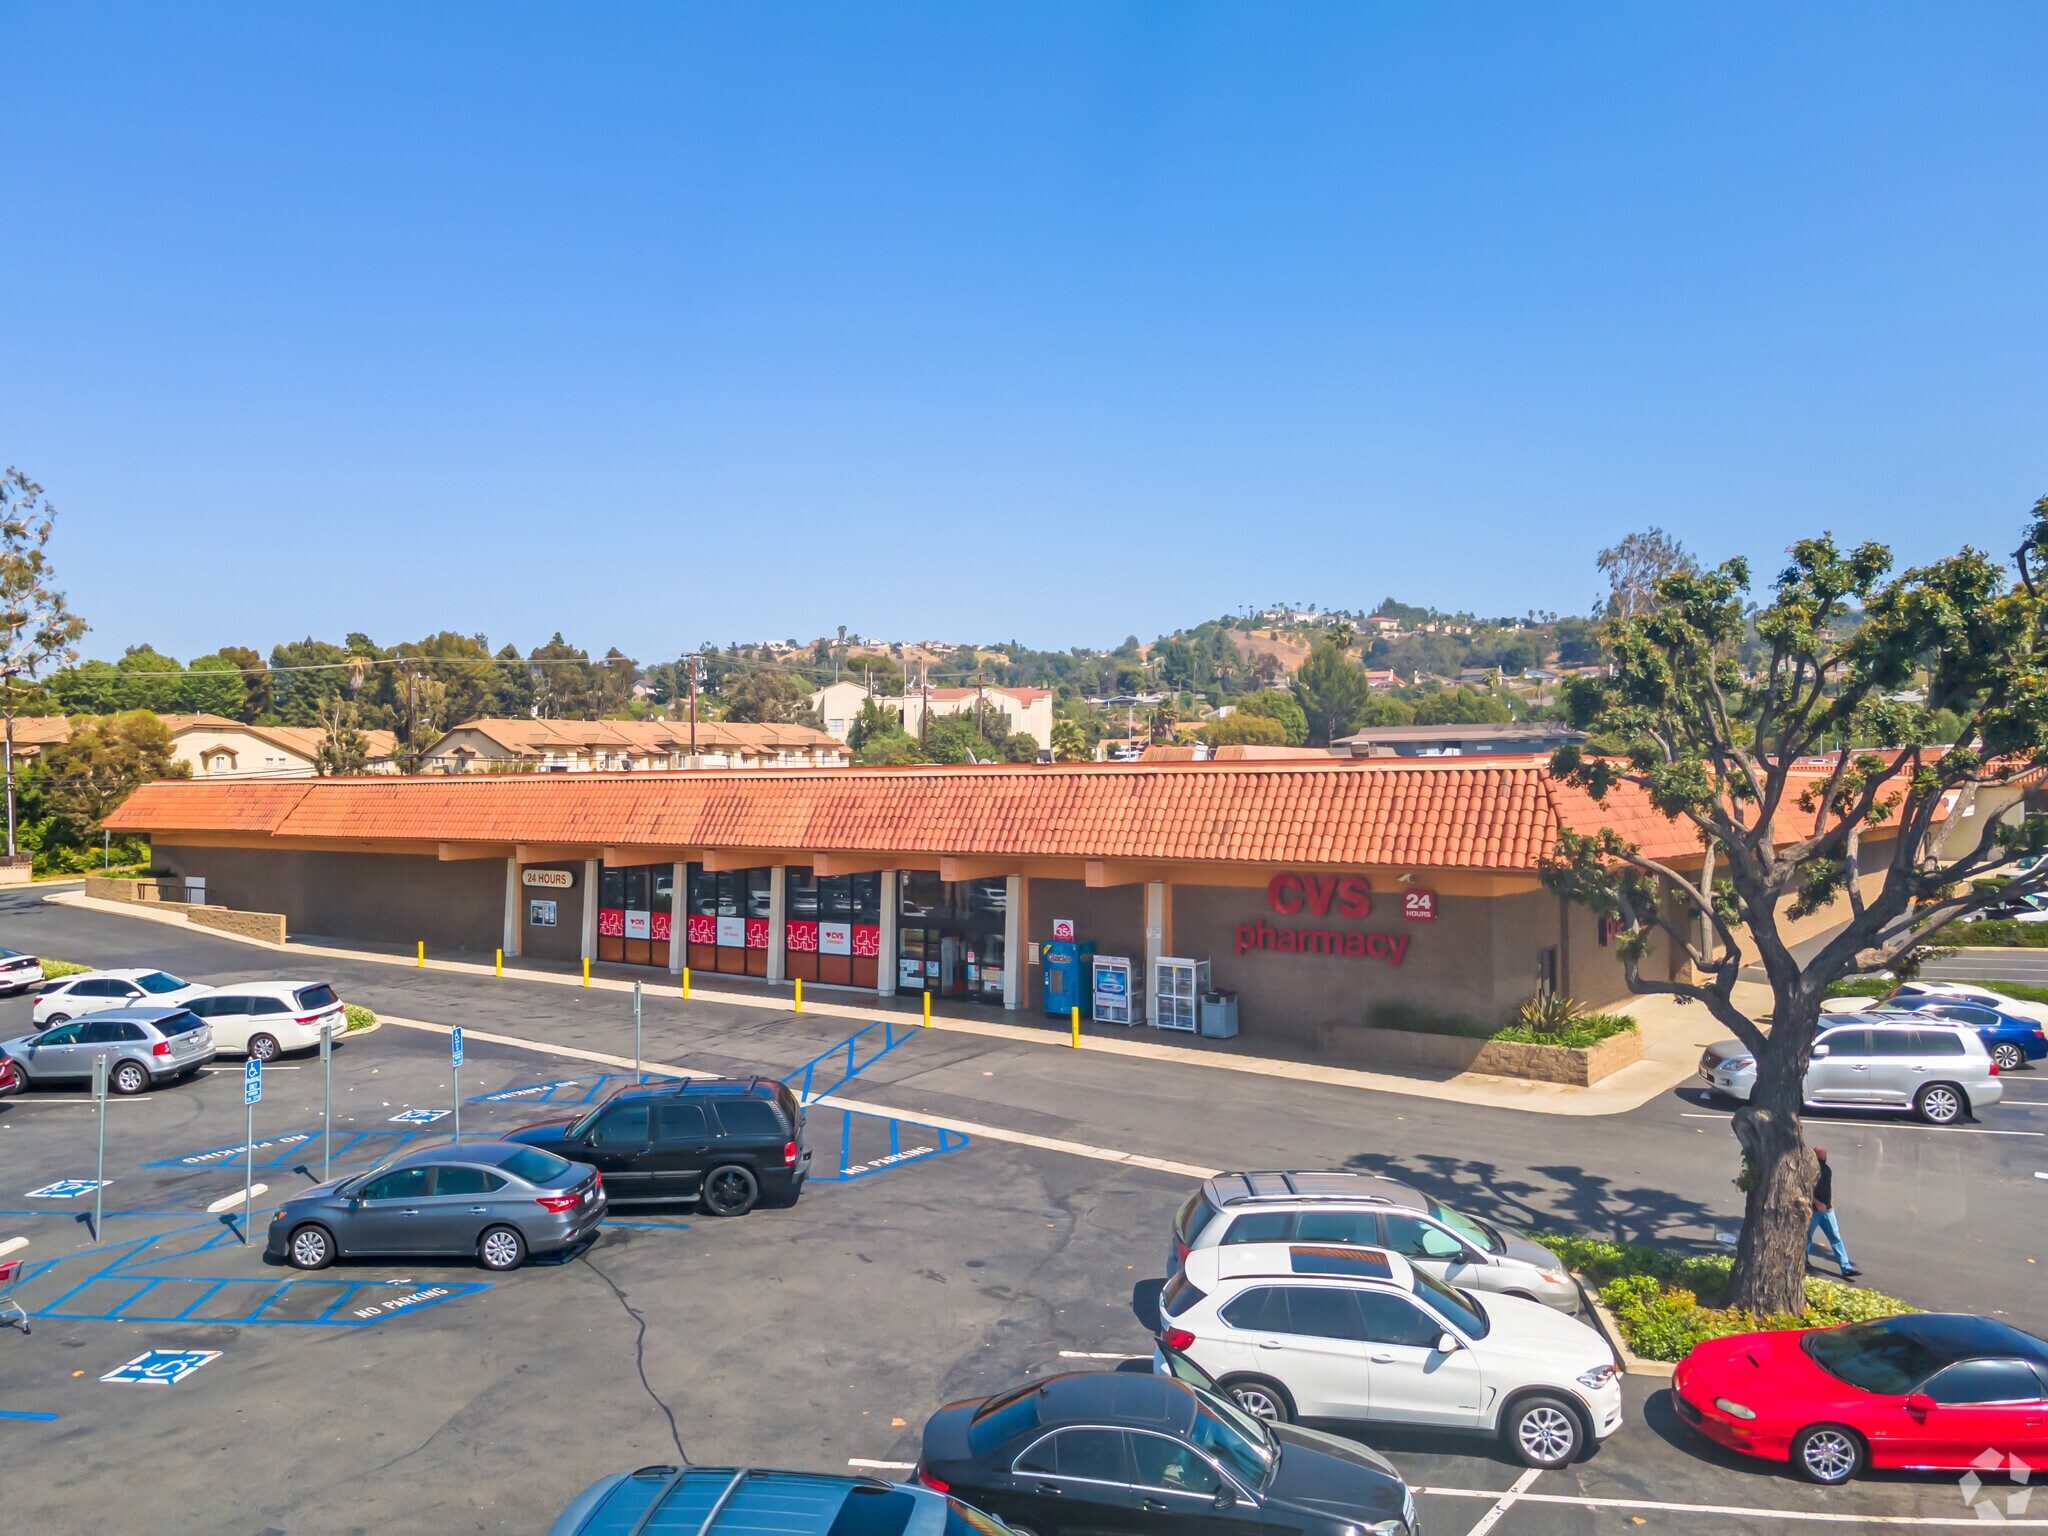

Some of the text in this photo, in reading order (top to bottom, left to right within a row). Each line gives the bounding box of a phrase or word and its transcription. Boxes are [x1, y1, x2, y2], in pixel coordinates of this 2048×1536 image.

[527, 873, 567, 885] 24 HOURS
[1268, 873, 1372, 919] CVS
[1405, 893, 1432, 910] 24
[635, 918, 645, 926] CVS
[1405, 910, 1432, 918] HOURS
[831, 932, 844, 940] CVS
[1235, 918, 1411, 967] pharmacy
[182, 1134, 310, 1164] NO PARKING
[840, 1146, 934, 1175] NO PARKING
[353, 1287, 449, 1318] NO PARKING
